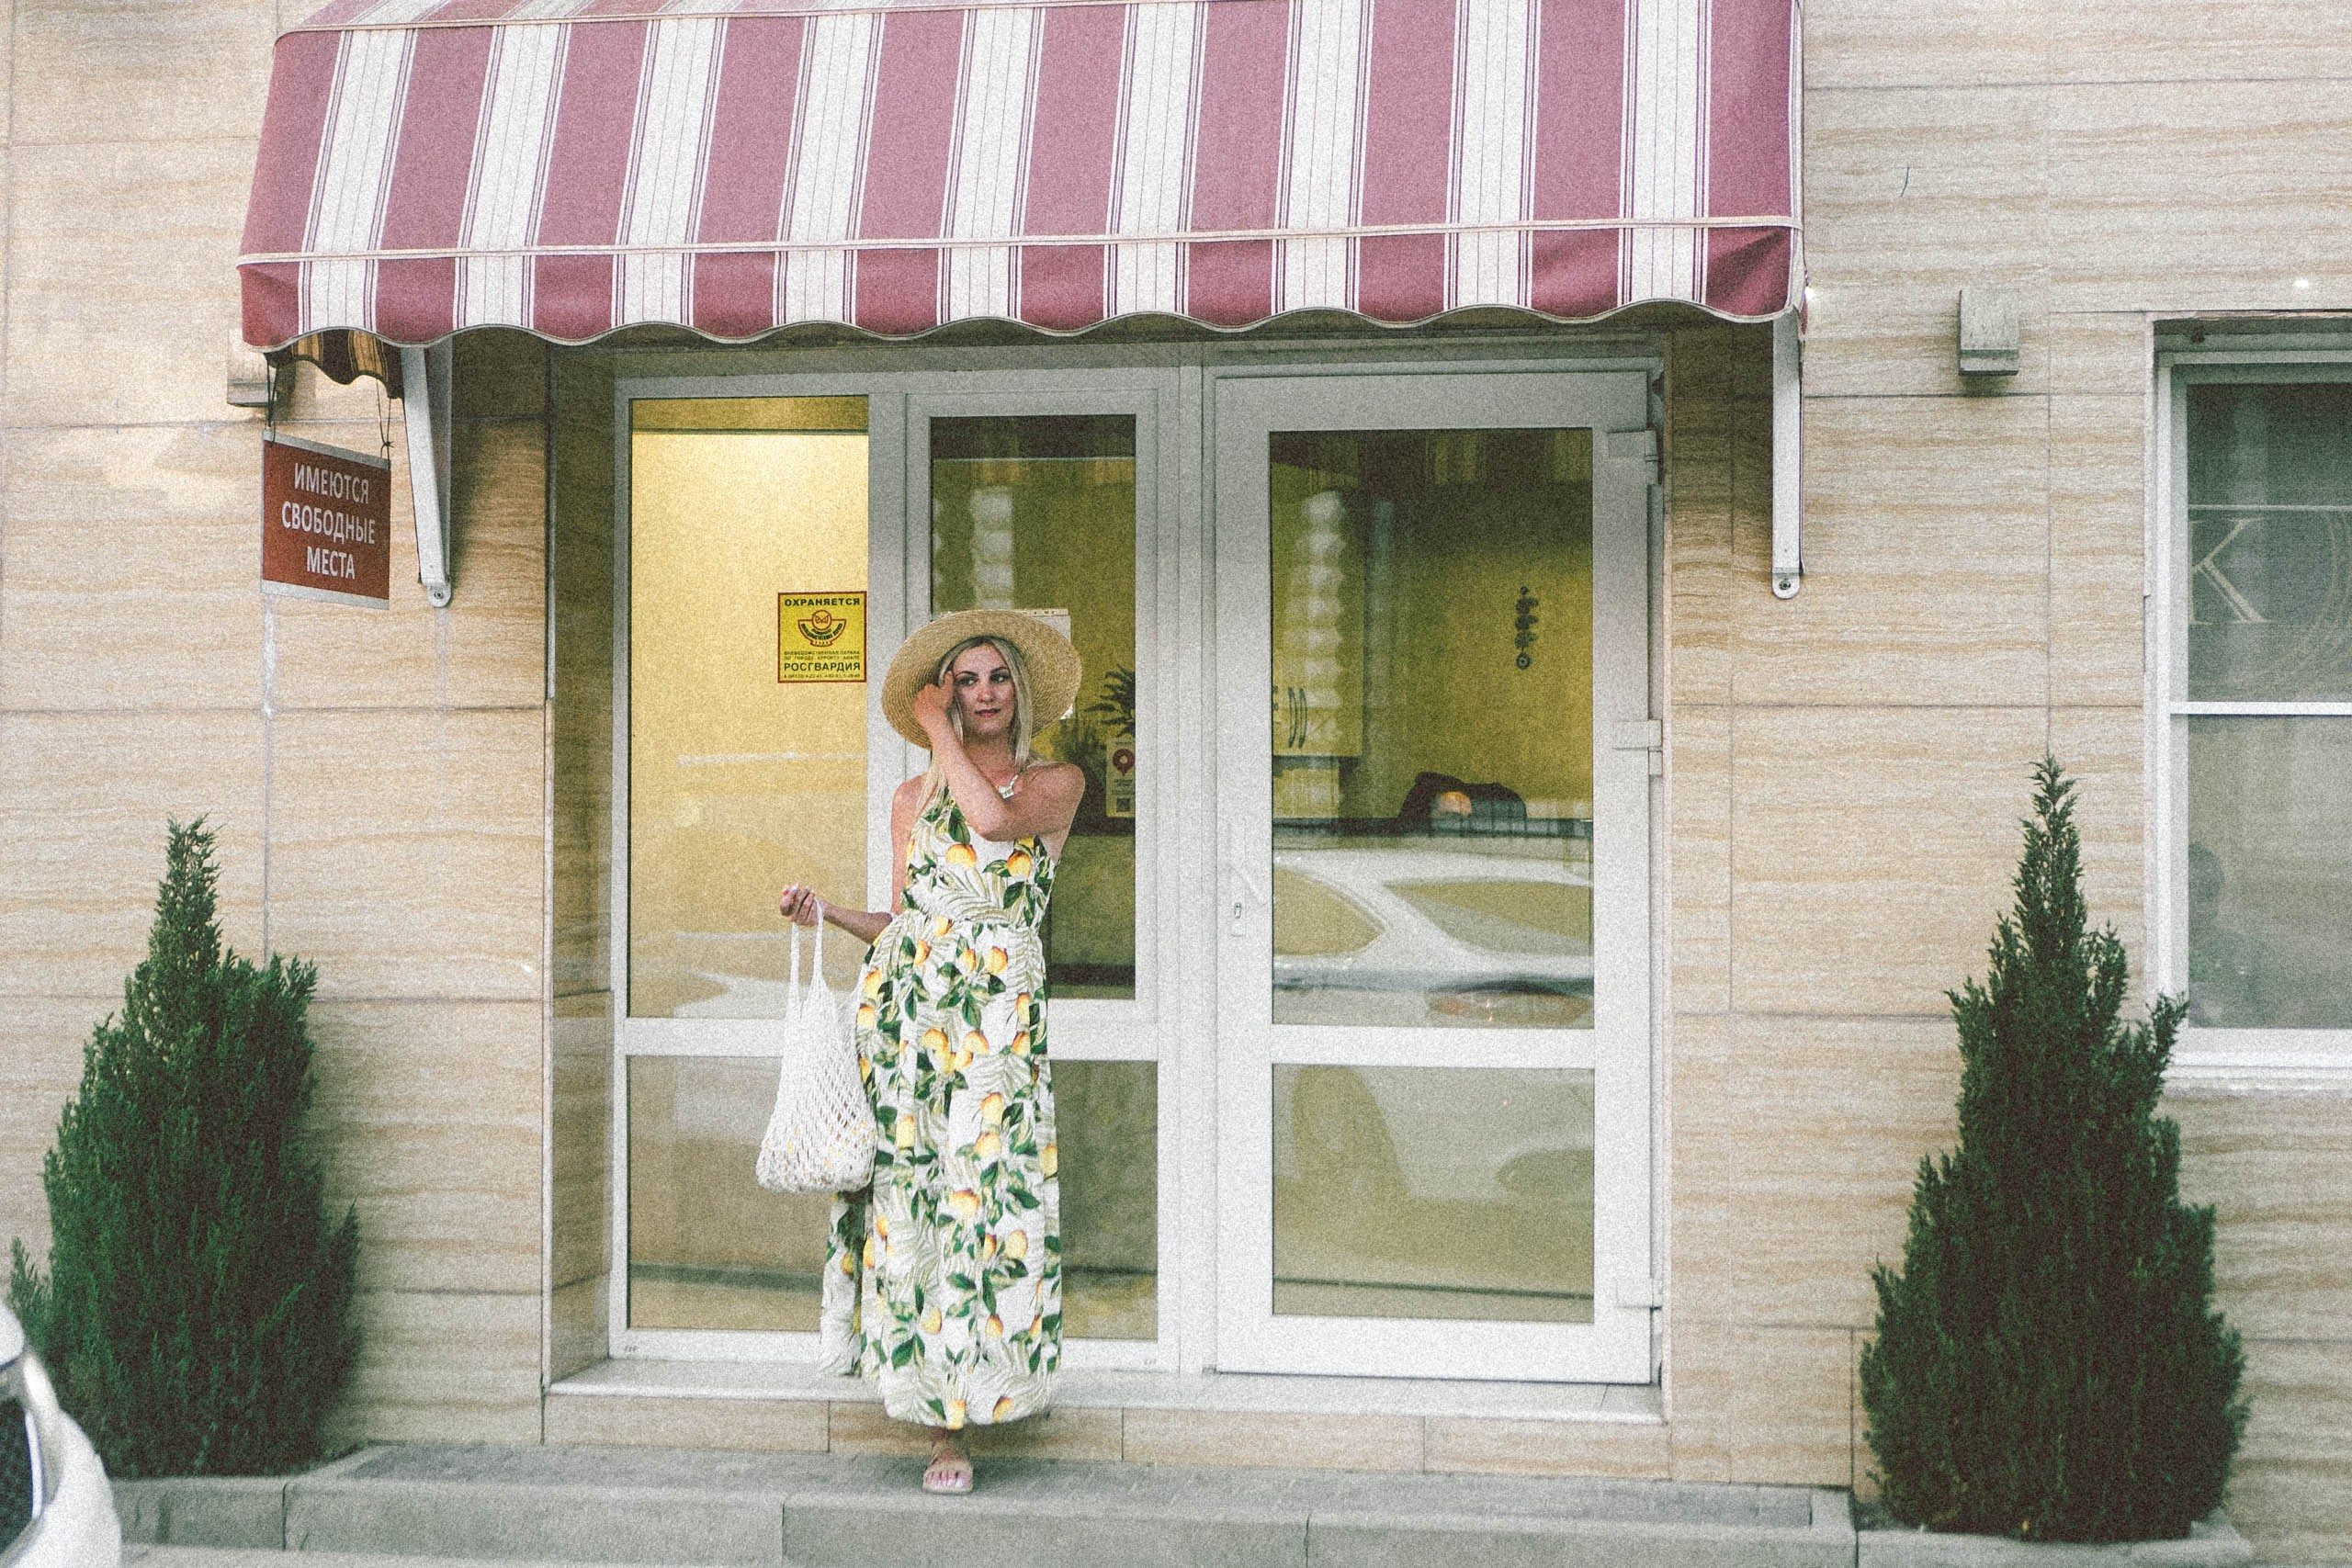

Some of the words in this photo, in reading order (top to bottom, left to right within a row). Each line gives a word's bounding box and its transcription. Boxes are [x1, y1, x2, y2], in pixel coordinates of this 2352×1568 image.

[294, 462, 369, 504] ИМЕЮТСЯ
[281, 501, 376, 545] СВОБОДНЫЕ
[306, 546, 356, 580] МЕСТА
[784, 598, 861, 606] ОХРАНЯЕТСЯ
[784, 662, 861, 672] РОСГВАРДИЯ
